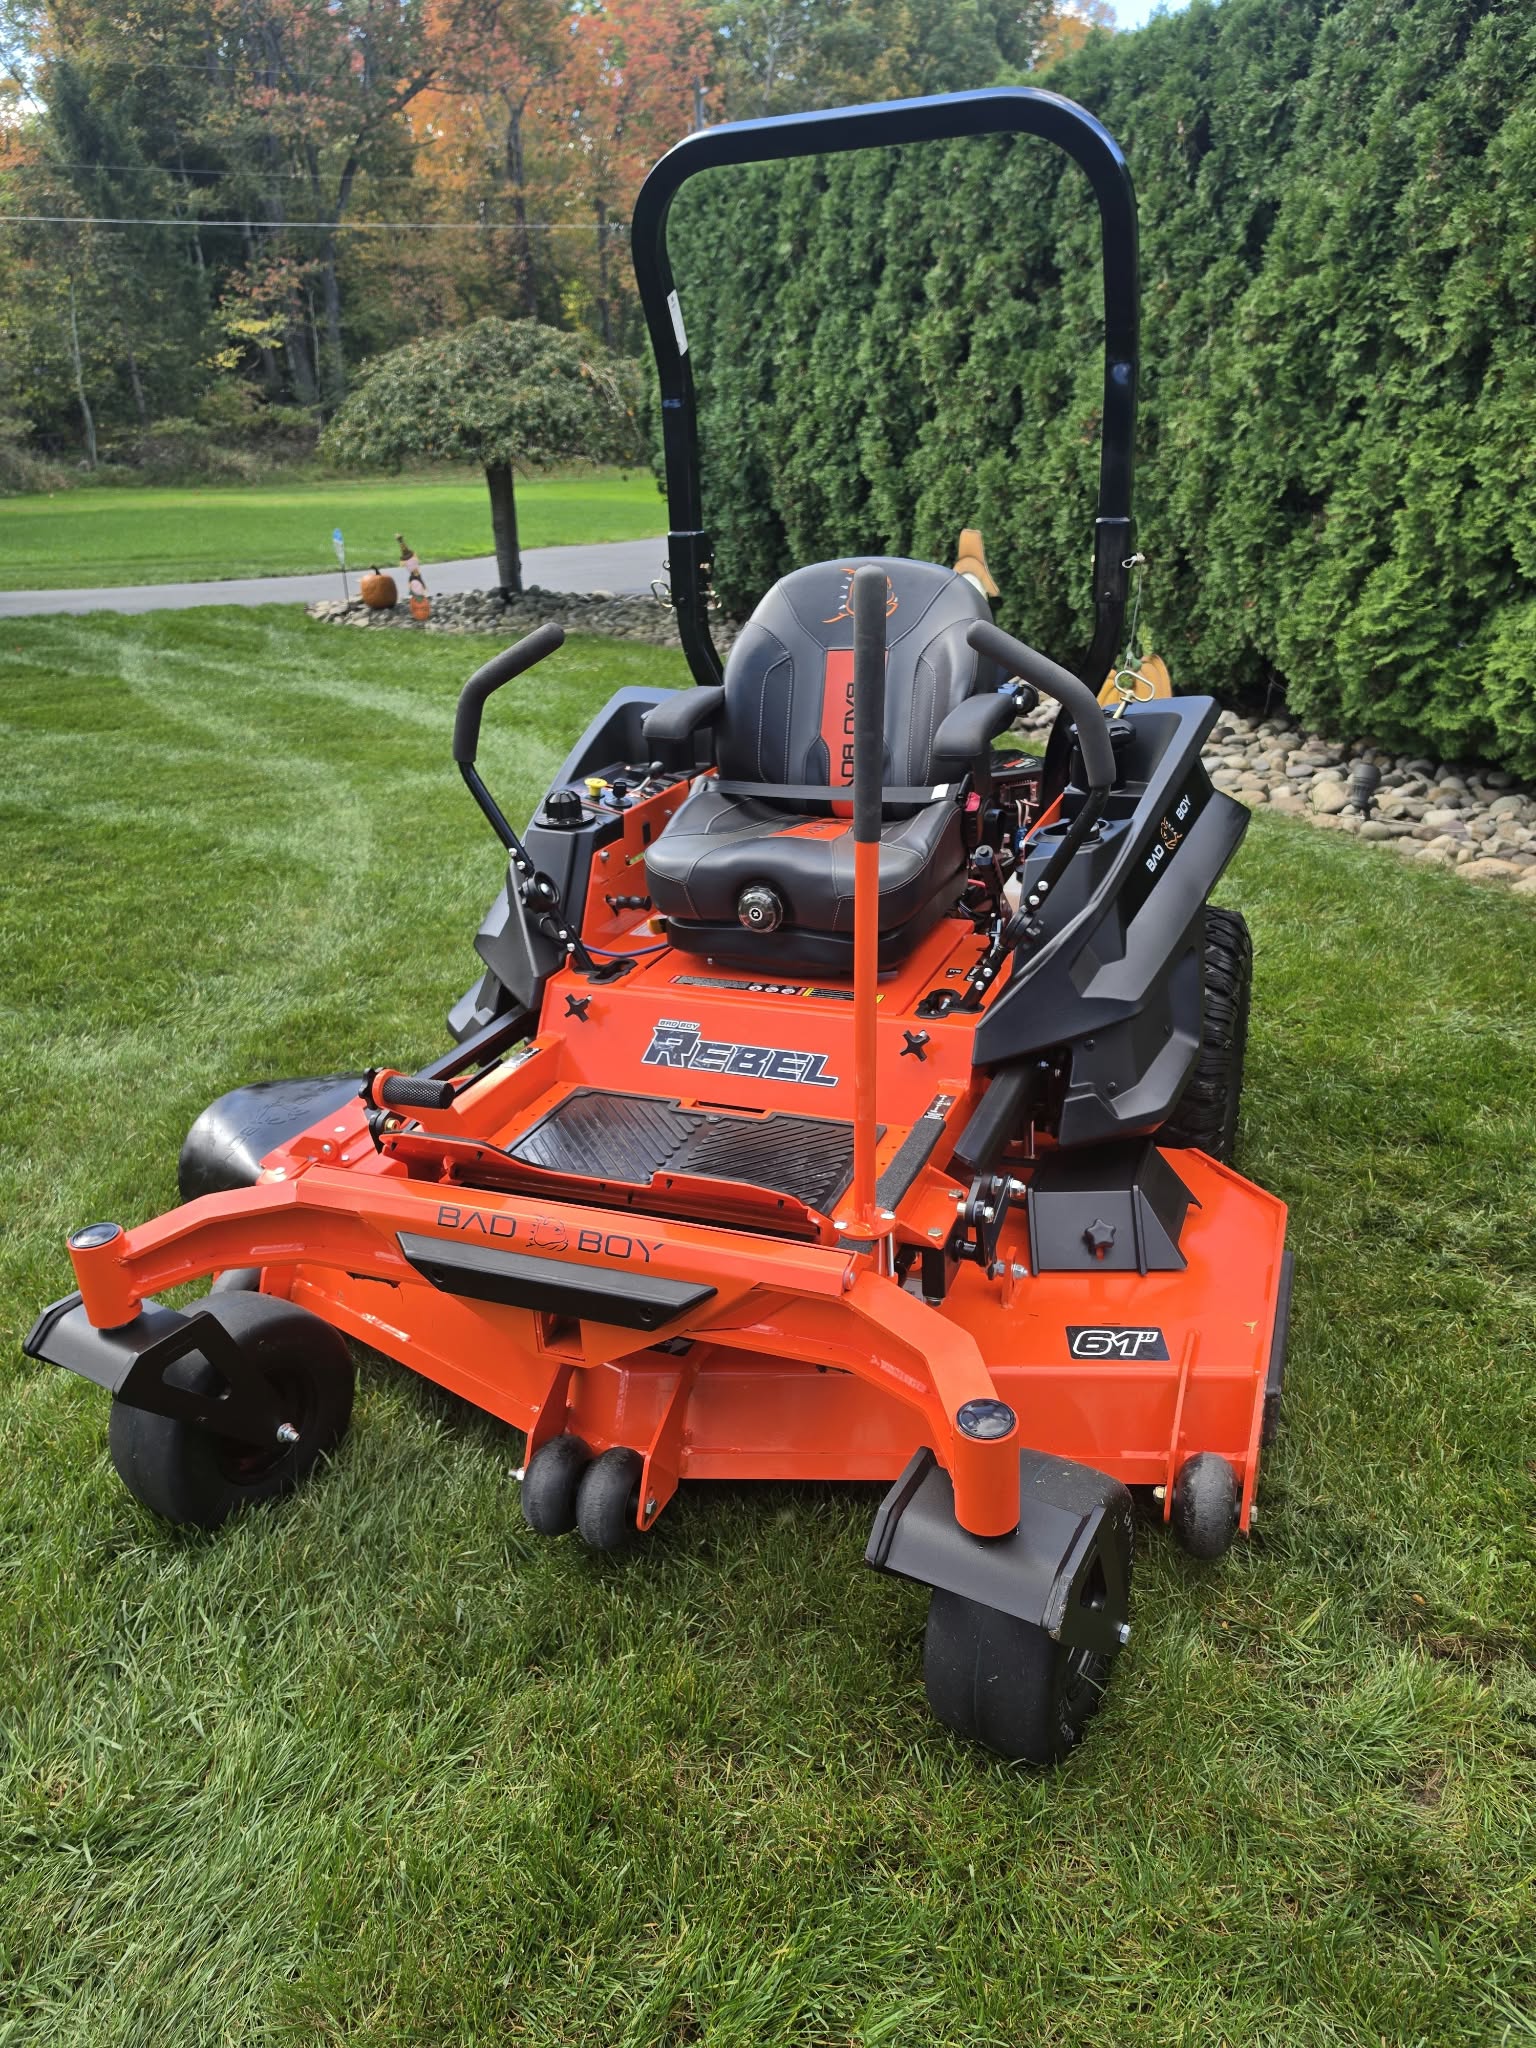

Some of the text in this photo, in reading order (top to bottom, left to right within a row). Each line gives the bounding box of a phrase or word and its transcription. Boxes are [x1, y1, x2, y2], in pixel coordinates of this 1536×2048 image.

[1145, 794, 1191, 872] BAD BOY
[658, 1019, 700, 1030] BAD BOY
[641, 1026, 838, 1087] REBEL
[436, 1205, 664, 1263] BAD BOY
